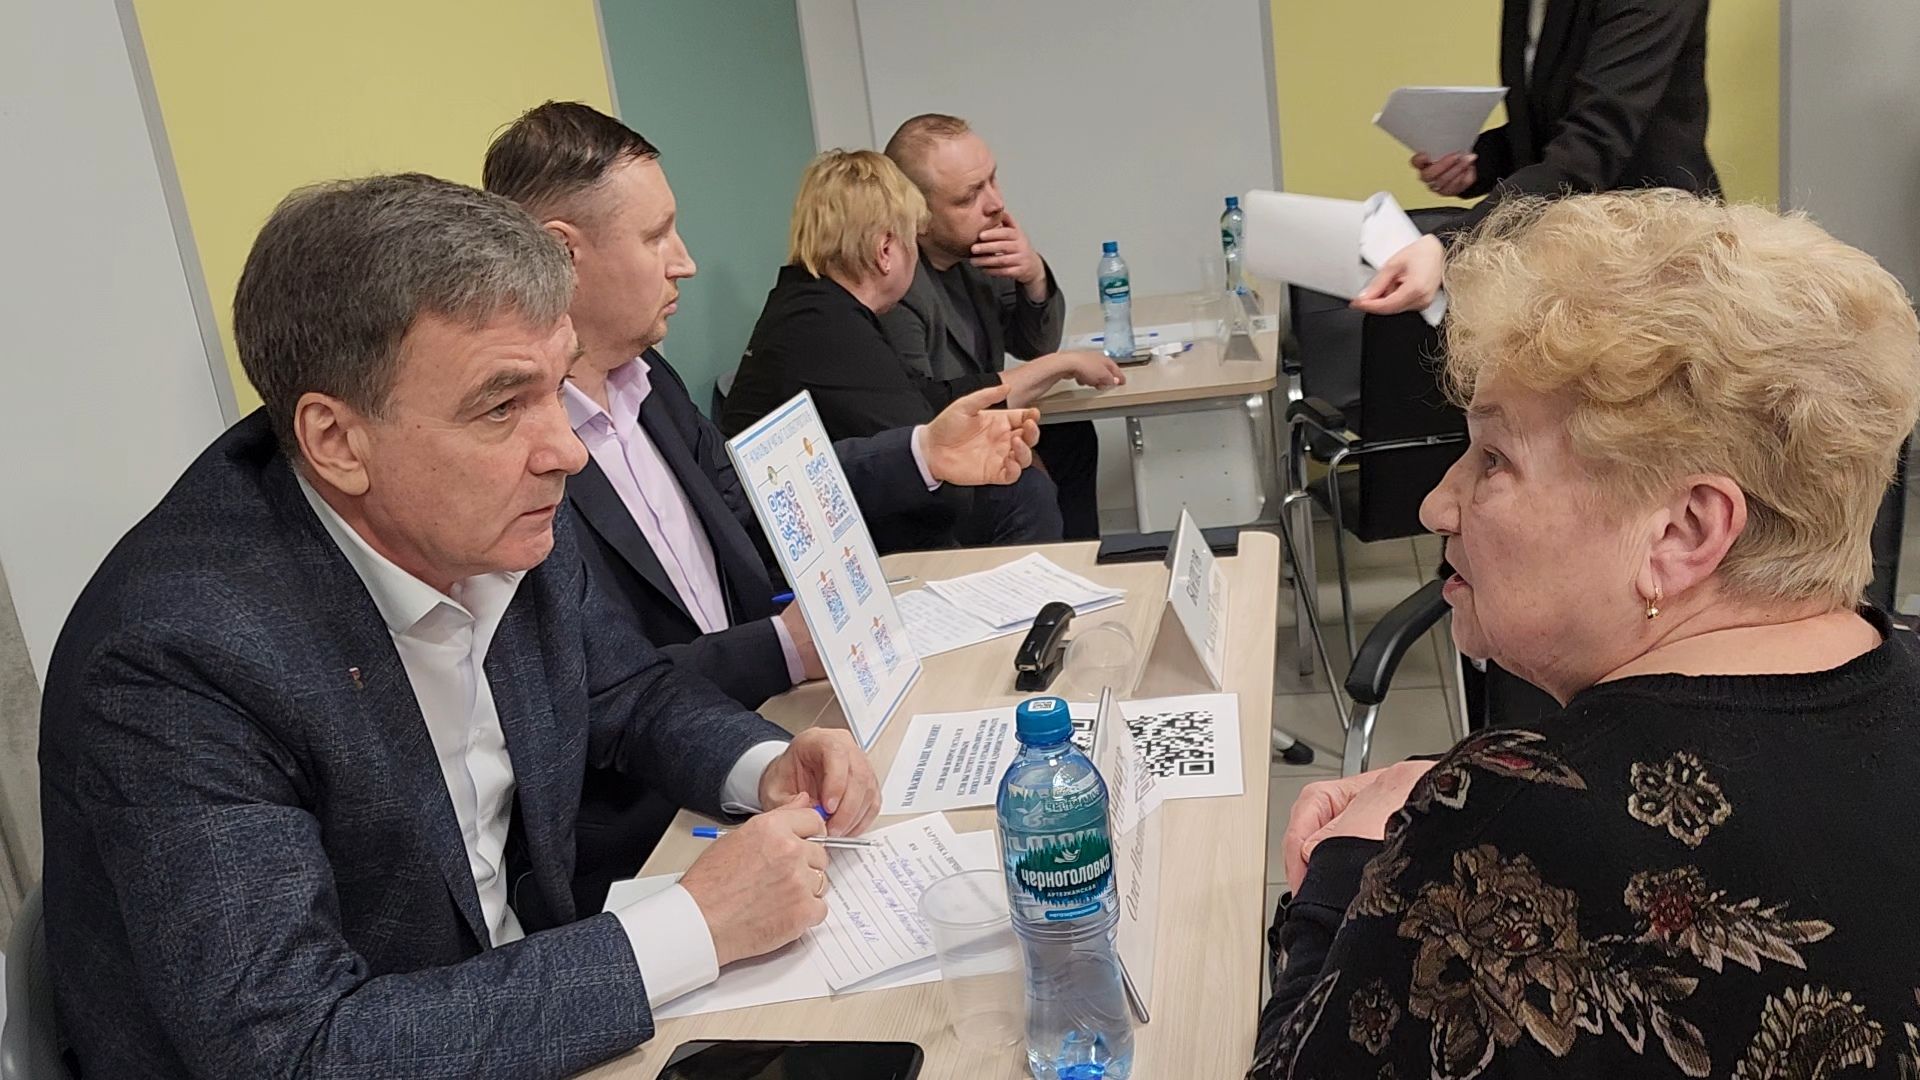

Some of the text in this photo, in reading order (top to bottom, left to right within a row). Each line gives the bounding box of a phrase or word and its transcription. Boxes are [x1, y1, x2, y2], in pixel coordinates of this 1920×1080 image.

[916, 749, 932, 767] ВАШЕ
[906, 767, 925, 790] ВАЖНО
[900, 790, 916, 806] НАМ
